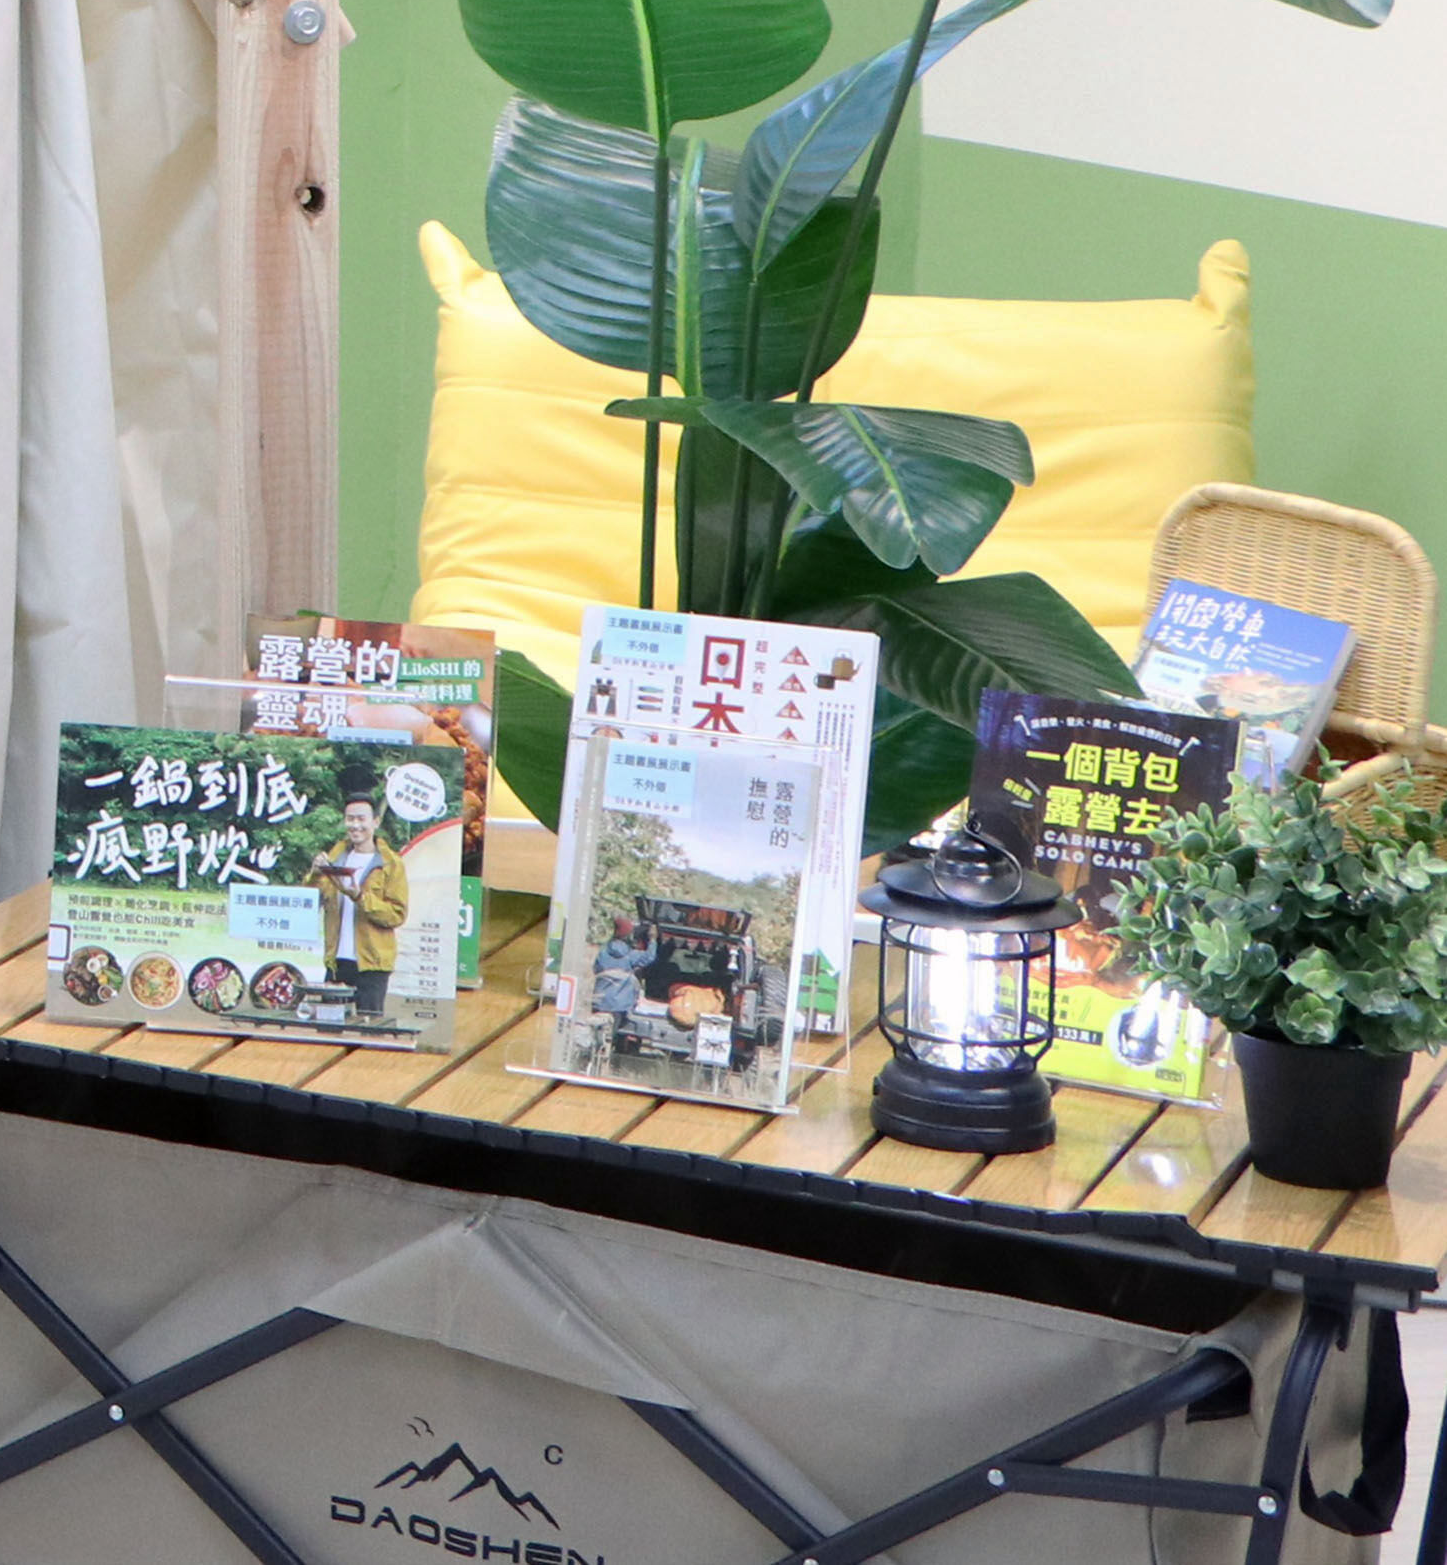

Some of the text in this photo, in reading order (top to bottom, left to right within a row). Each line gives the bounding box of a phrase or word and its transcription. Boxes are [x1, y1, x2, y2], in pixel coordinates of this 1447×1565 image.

[1160, 591, 1265, 642] 開露營車
[258, 634, 401, 687] 露營的
[401, 659, 481, 677] LiloSHI 的
[1155, 624, 1256, 671] 玩大自然
[691, 635, 746, 734] 日本
[253, 690, 348, 733] 靈魂
[85, 753, 308, 824] 一鍋到底
[1025, 742, 1179, 793] 一個背包
[746, 777, 769, 821] 撫慰
[769, 780, 795, 849] 露營的
[1044, 785, 1161, 835] 露營去
[67, 809, 270, 889] 瘋野炊
[1033, 845, 1086, 864] SOLO
